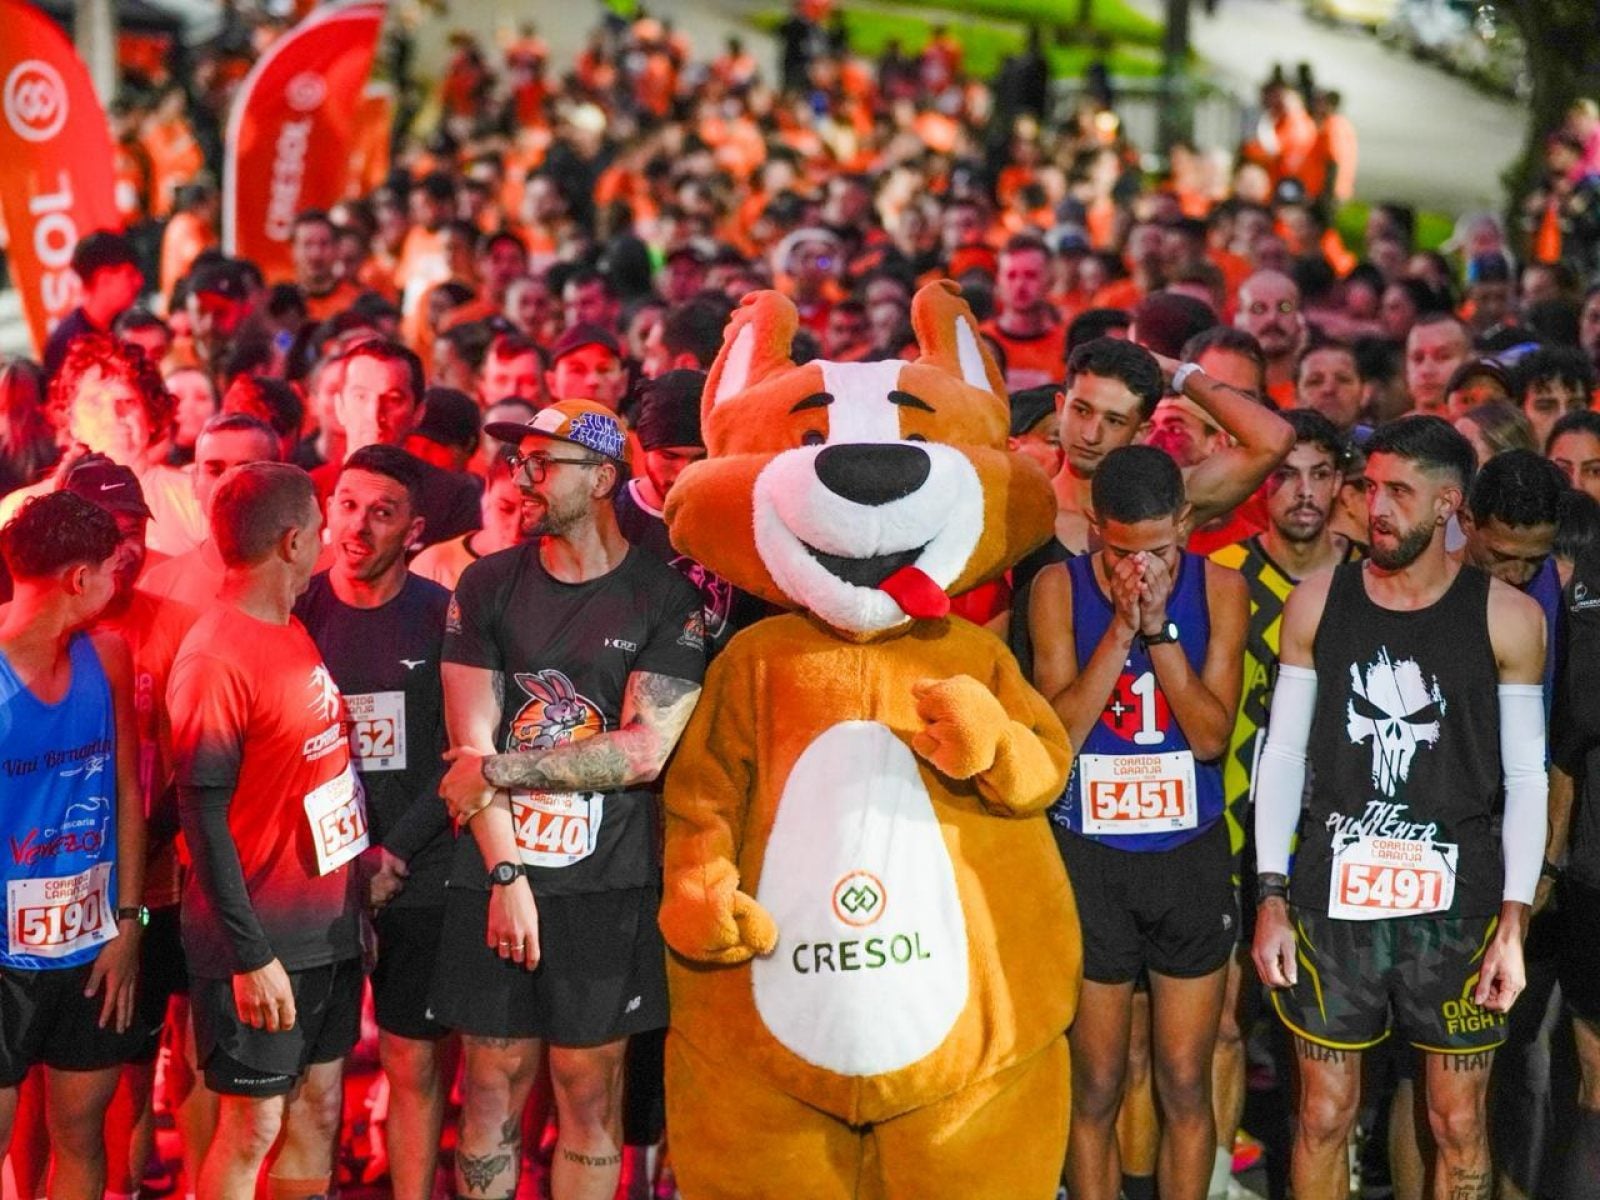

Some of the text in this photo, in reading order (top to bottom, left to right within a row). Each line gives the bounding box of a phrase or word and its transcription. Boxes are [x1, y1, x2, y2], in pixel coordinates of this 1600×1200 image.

[29, 171, 86, 334] SOL
[1113, 756, 1162, 768] CORRIDA
[1113, 766, 1162, 776] LARANJA
[1096, 780, 1181, 820] 5451
[1361, 800, 1409, 827] THE
[1371, 839, 1424, 852] CORRIDA
[1371, 849, 1423, 862] LARANJA
[1345, 865, 1436, 909] 5491
[23, 893, 99, 946] 5190
[792, 931, 931, 975] CRESOL
[1442, 998, 1482, 1019] ON
